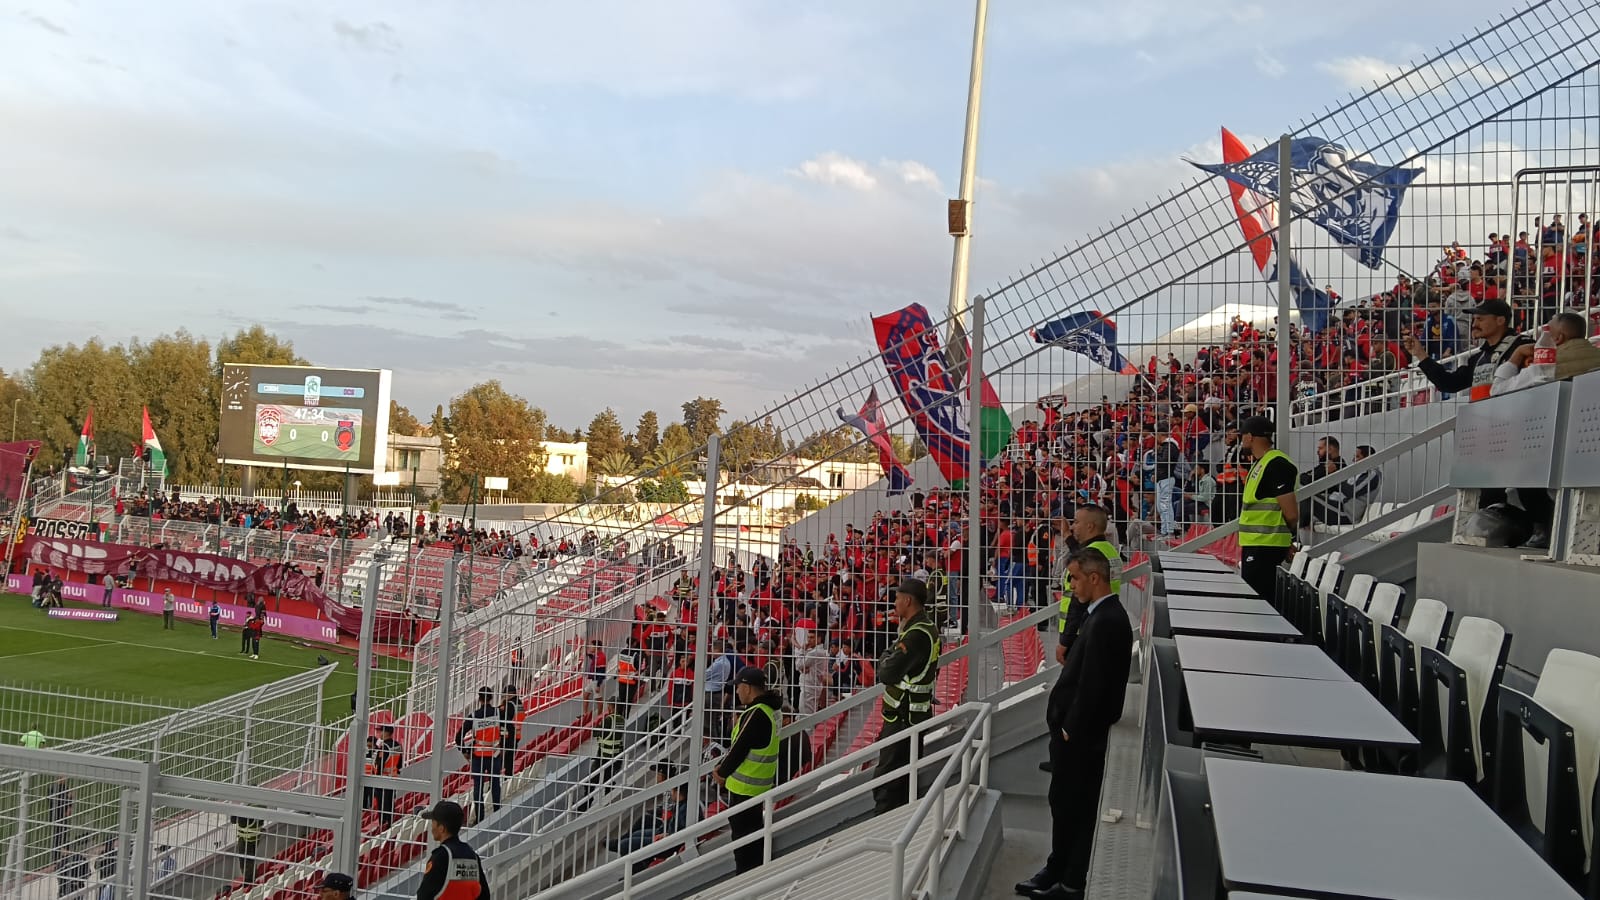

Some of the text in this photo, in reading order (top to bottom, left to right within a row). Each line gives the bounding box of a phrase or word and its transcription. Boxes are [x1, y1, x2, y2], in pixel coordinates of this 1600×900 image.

[294, 408, 325, 421] 47:34
[290, 428, 329, 442] 0 0
[122, 594, 150, 607] inwi
